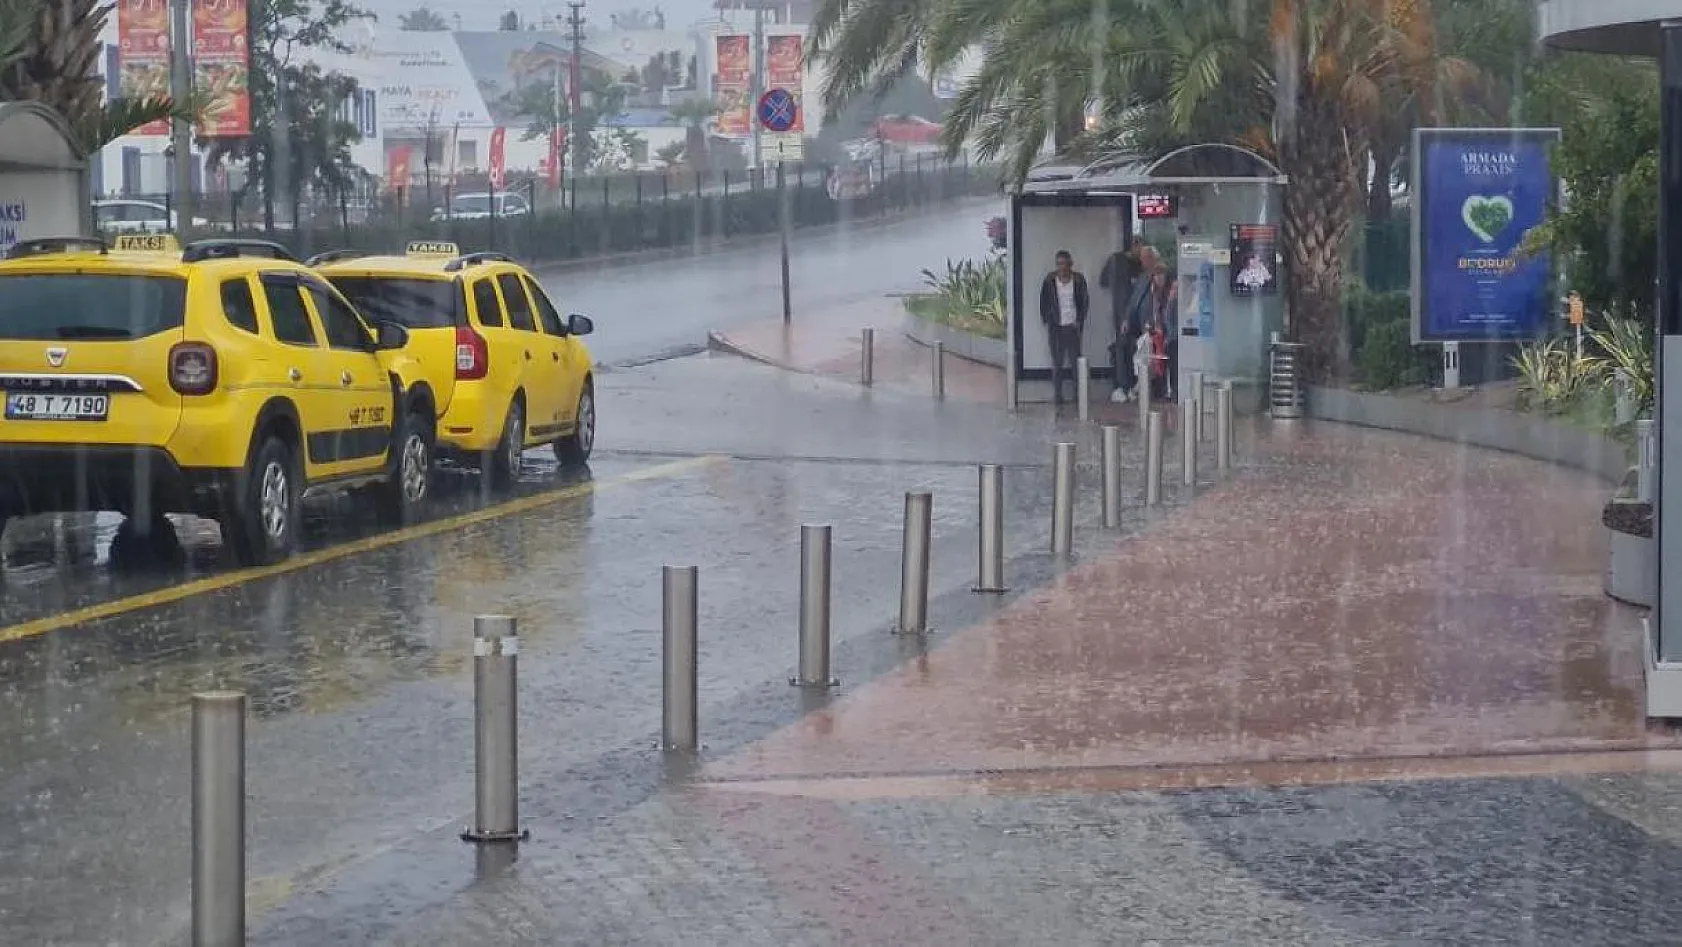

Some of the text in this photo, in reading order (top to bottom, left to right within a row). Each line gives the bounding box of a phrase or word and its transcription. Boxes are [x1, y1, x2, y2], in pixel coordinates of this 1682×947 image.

[1460, 152, 1516, 164] ARMADA
[16, 396, 105, 413] 48 T 7190
